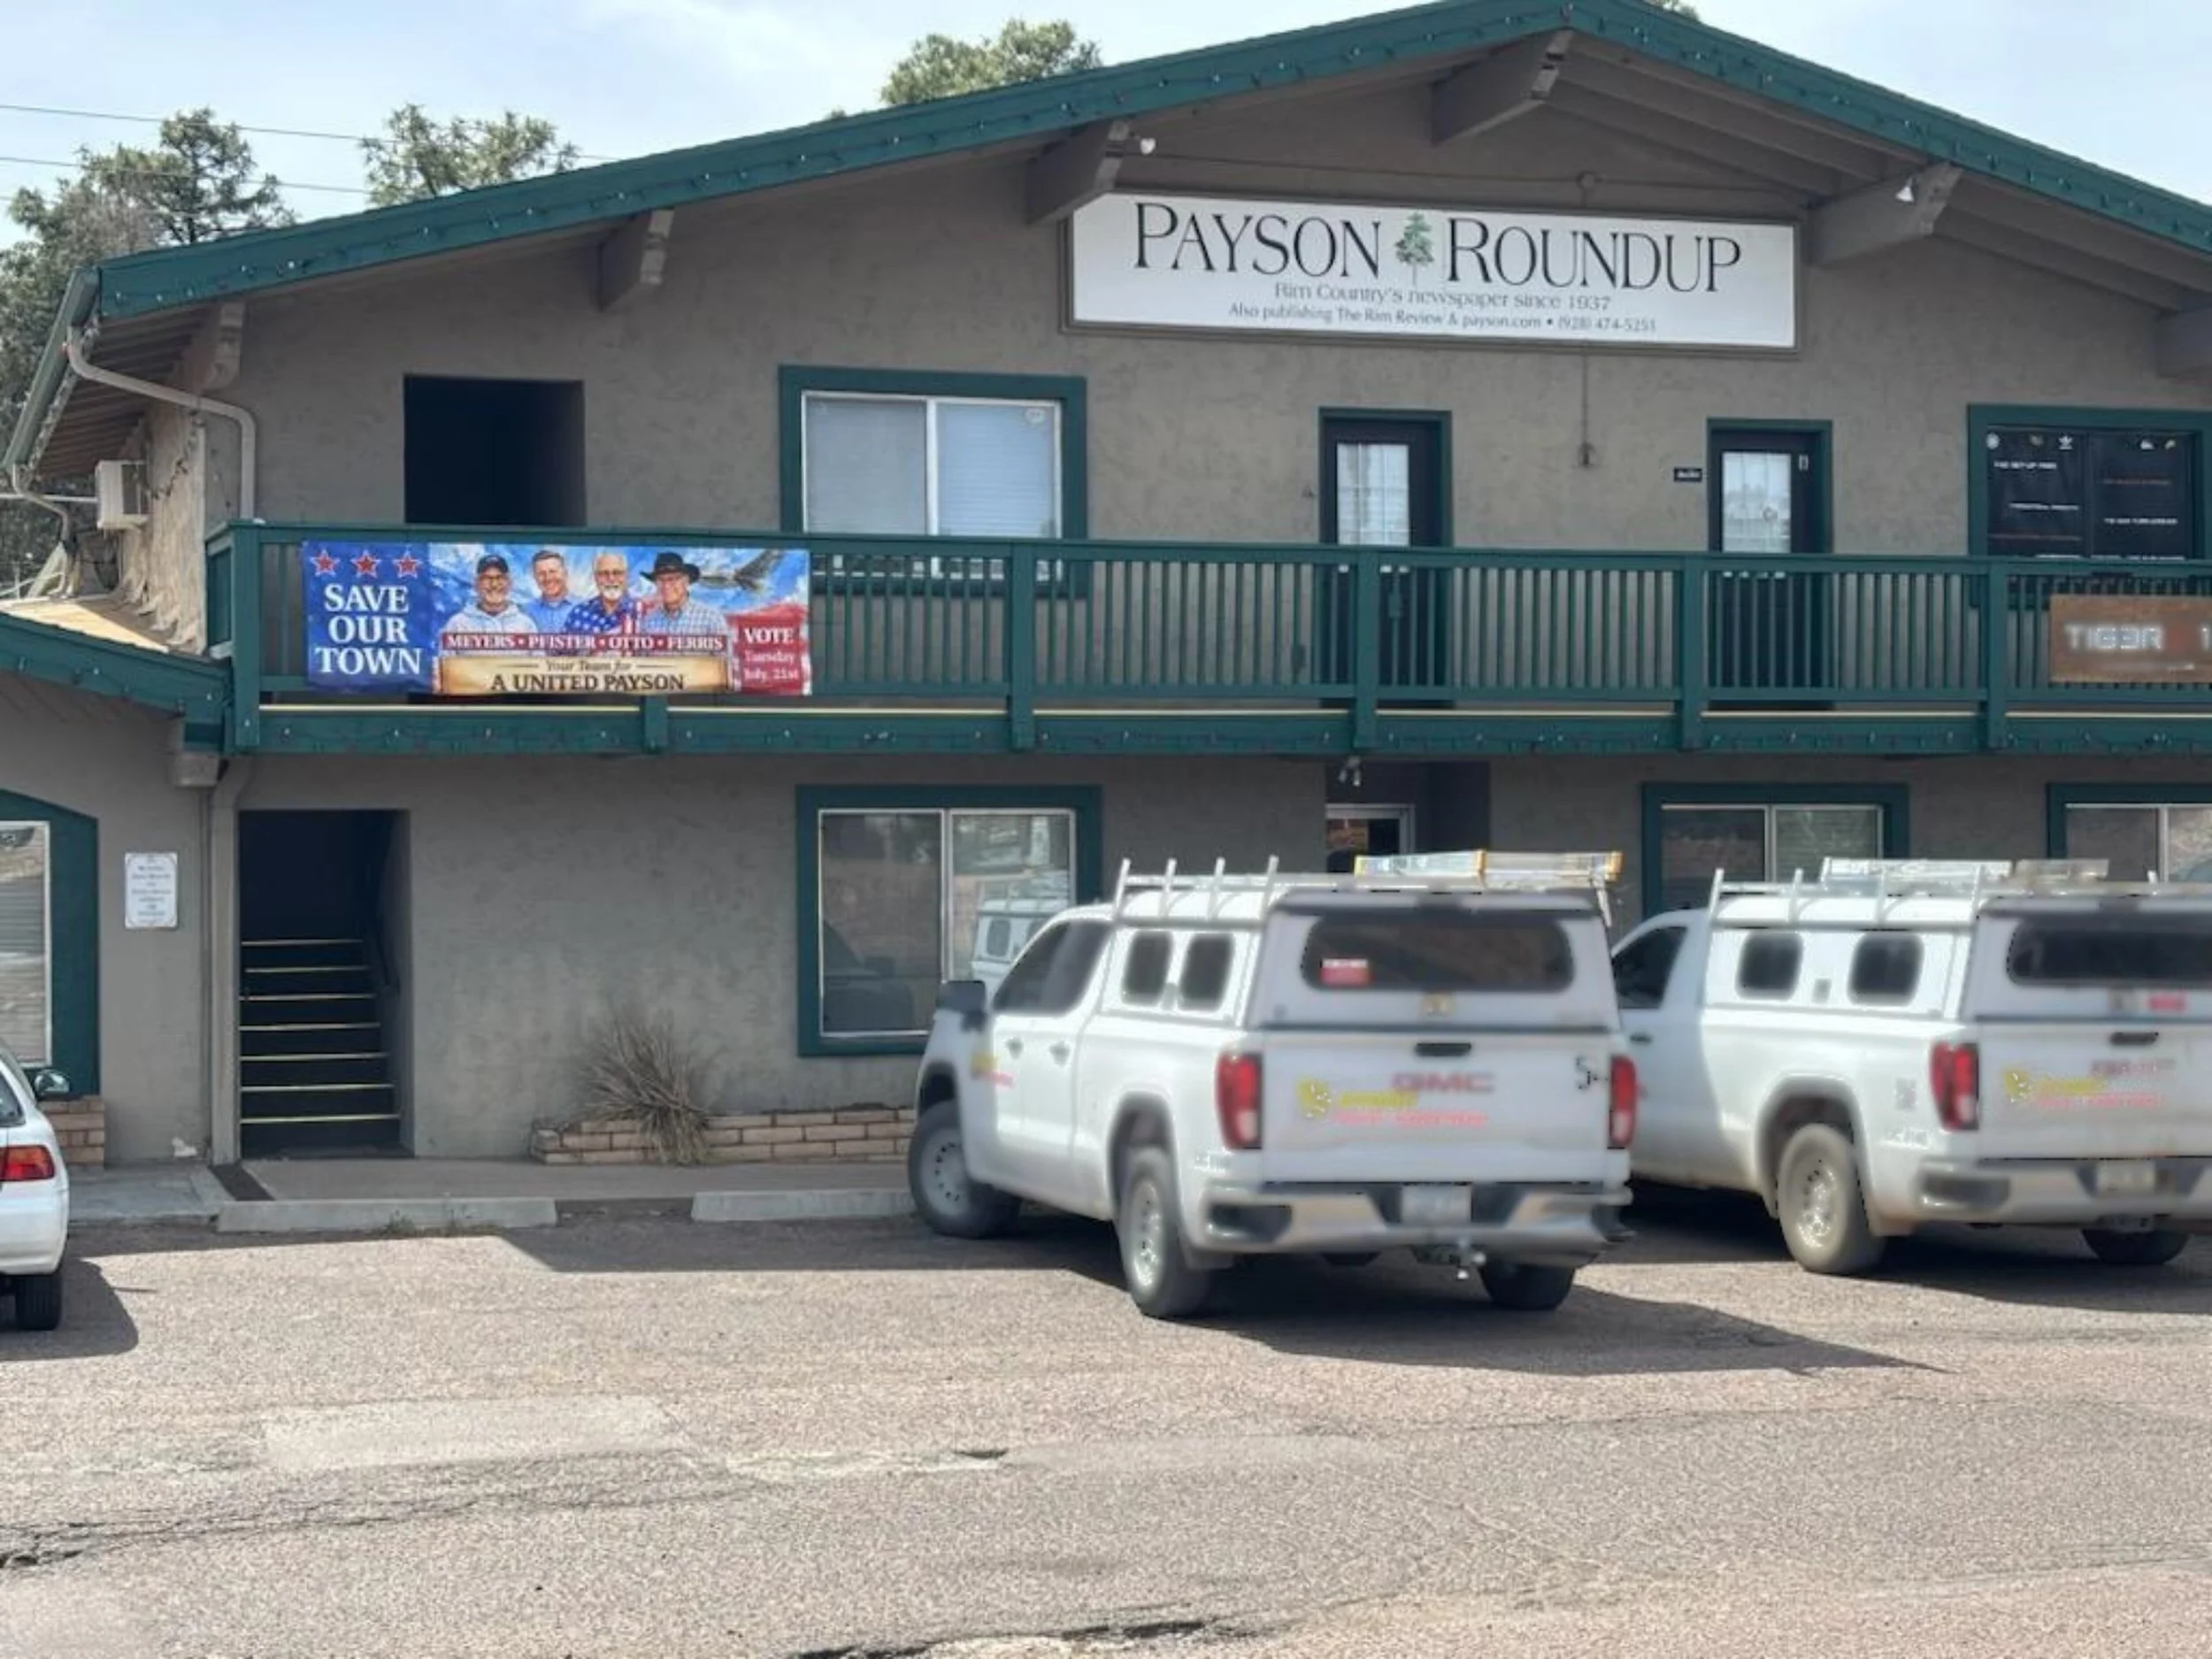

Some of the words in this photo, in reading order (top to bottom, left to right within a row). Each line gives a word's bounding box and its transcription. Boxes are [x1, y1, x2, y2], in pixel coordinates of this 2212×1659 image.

[1134, 202, 1381, 279] PAYSON
[1447, 217, 1741, 293] ROUNDUP
[1275, 282, 1312, 300] Rim
[1317, 283, 1403, 305] Country's
[1407, 288, 1509, 310] newspaper
[1514, 292, 1562, 310] since
[1570, 295, 1611, 311] 1937
[1228, 302, 1260, 318] Also
[1263, 303, 1332, 324] publishing
[1337, 304, 1363, 322] The
[1364, 305, 1392, 323] Rim
[1394, 307, 1443, 325] Review
[1462, 312, 1541, 330] payson.com
[324, 583, 409, 612] SAVE
[328, 615, 409, 644] OUR
[447, 634, 515, 648] MEYERS
[609, 635, 653, 649] OTTO
[744, 626, 795, 644] VOTE
[314, 647, 423, 674] TOWN
[545, 659, 574, 671] Your
[579, 660, 611, 671] Team
[744, 649, 795, 665] Tuesday
[490, 673, 507, 691] A
[512, 673, 599, 691] UNITED
[603, 673, 684, 691] PAYSON
[1392, 1071, 1495, 1094] GMC
